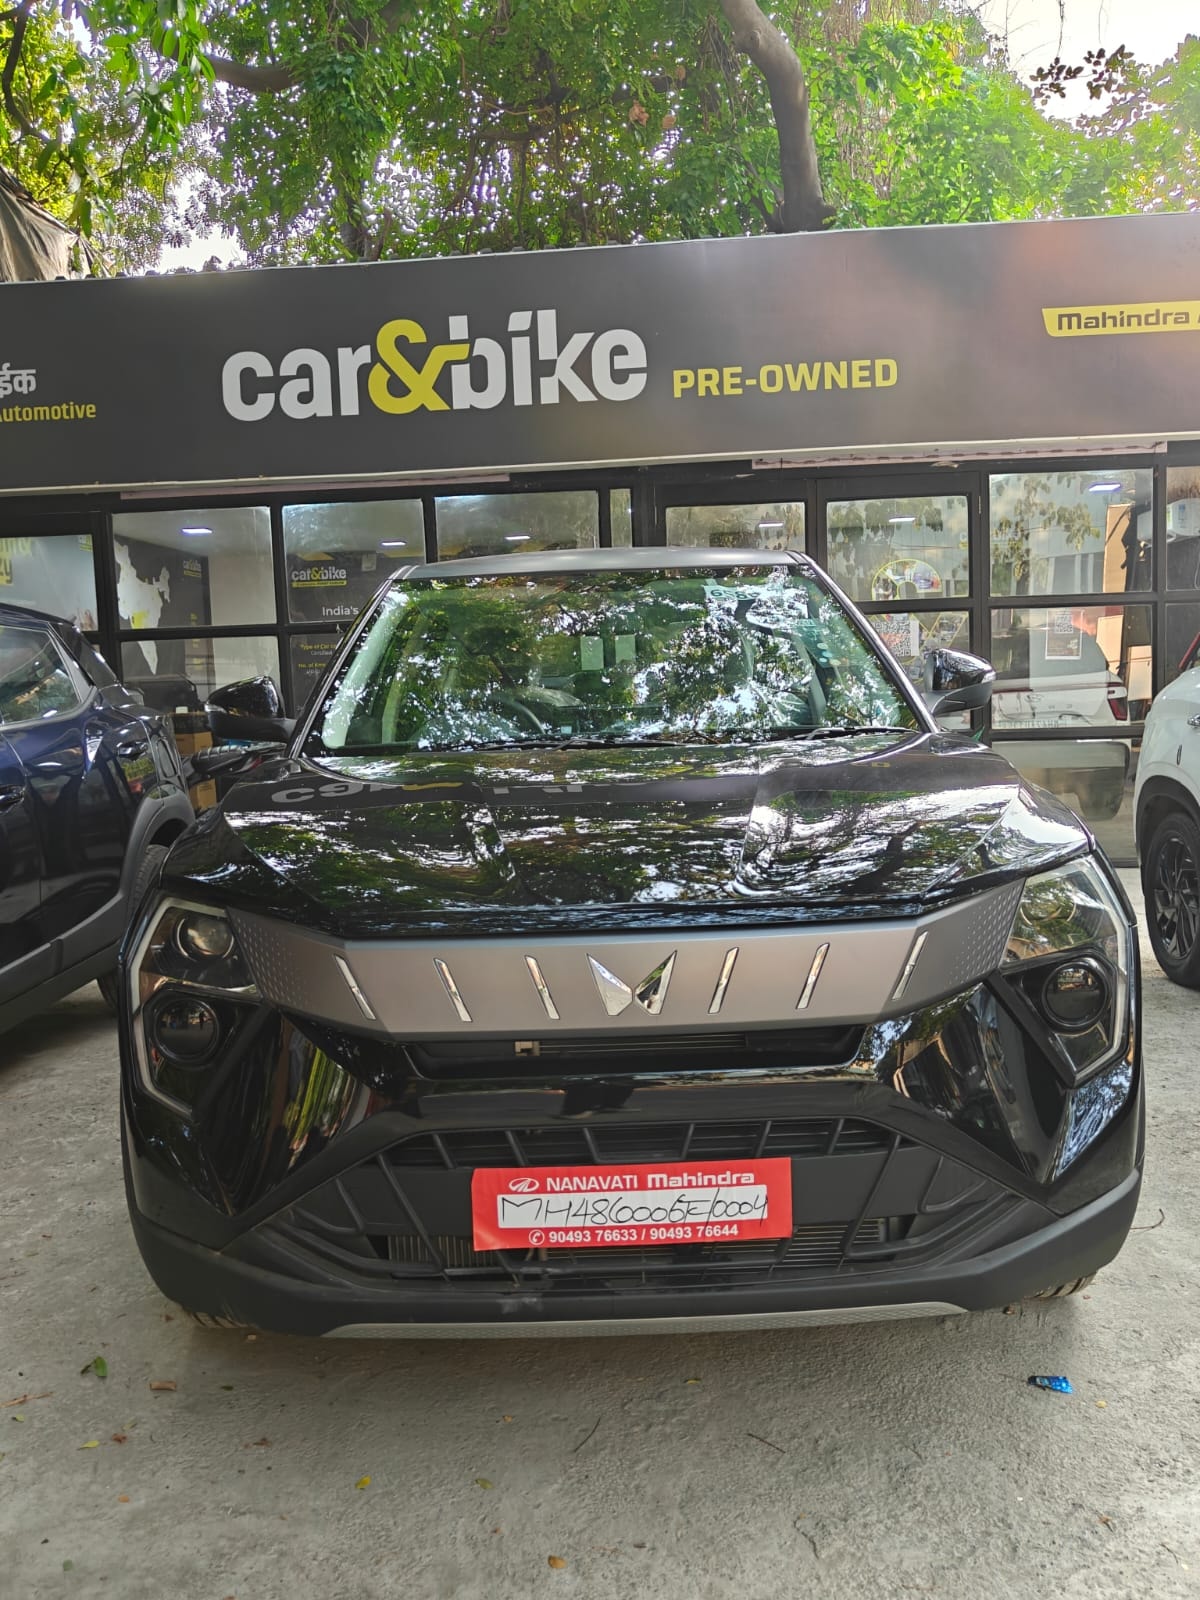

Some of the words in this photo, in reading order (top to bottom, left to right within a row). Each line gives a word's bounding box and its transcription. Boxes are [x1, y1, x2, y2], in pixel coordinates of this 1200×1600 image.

[1057, 309, 1190, 331] Mahindra
[222, 309, 648, 422] car&bike
[673, 358, 898, 399] PRE-OWNED
[0, 401, 97, 423] utomotive
[291, 566, 347, 581] car&bike
[322, 605, 359, 617] India's
[546, 1174, 639, 1192] NANAVATI
[647, 1171, 755, 1189] Mahindra
[549, 1230, 592, 1243] 90493
[595, 1228, 638, 1242] 76633
[650, 1226, 692, 1240] 90493
[696, 1225, 739, 1238] 76644
